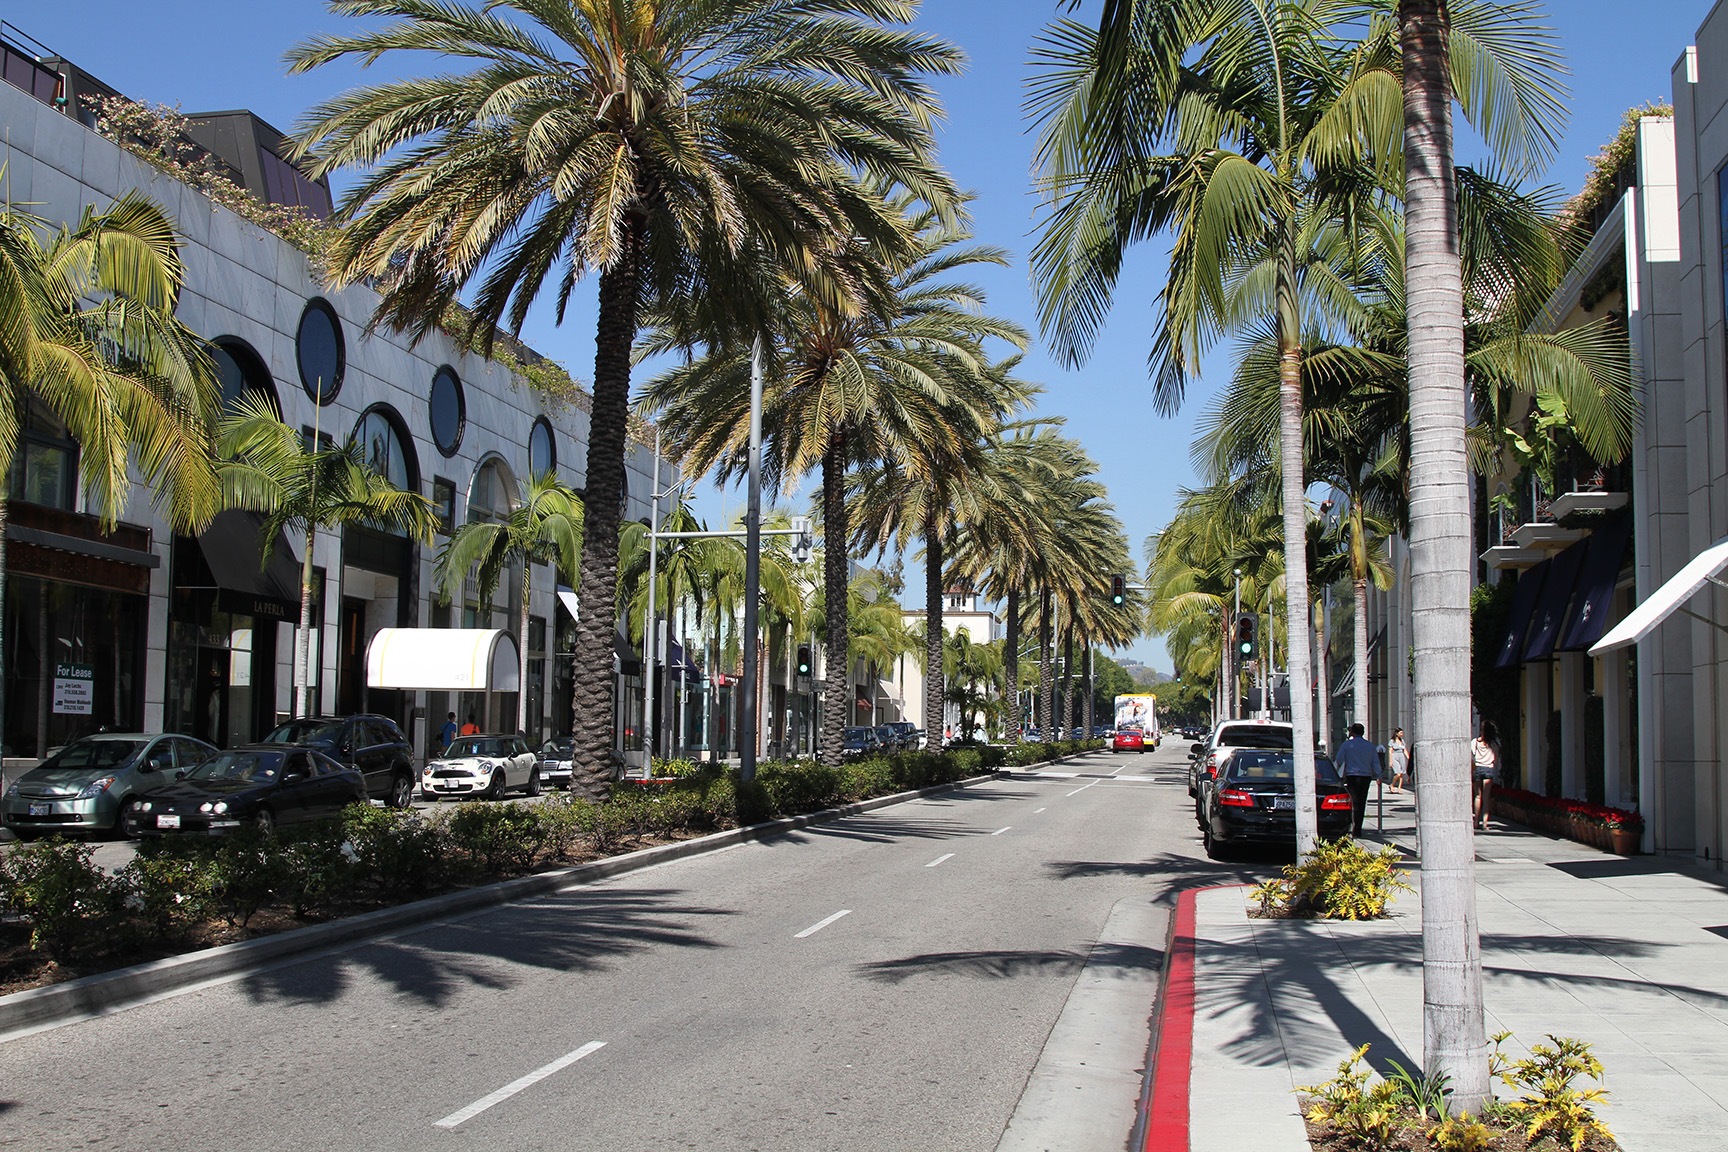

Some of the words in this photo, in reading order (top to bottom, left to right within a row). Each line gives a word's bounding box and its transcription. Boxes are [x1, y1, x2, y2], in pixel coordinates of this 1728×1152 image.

[254, 600, 262, 613] LA
[264, 603, 284, 616] PERLA
[57, 664, 70, 676] For
[71, 666, 92, 678] Lease
